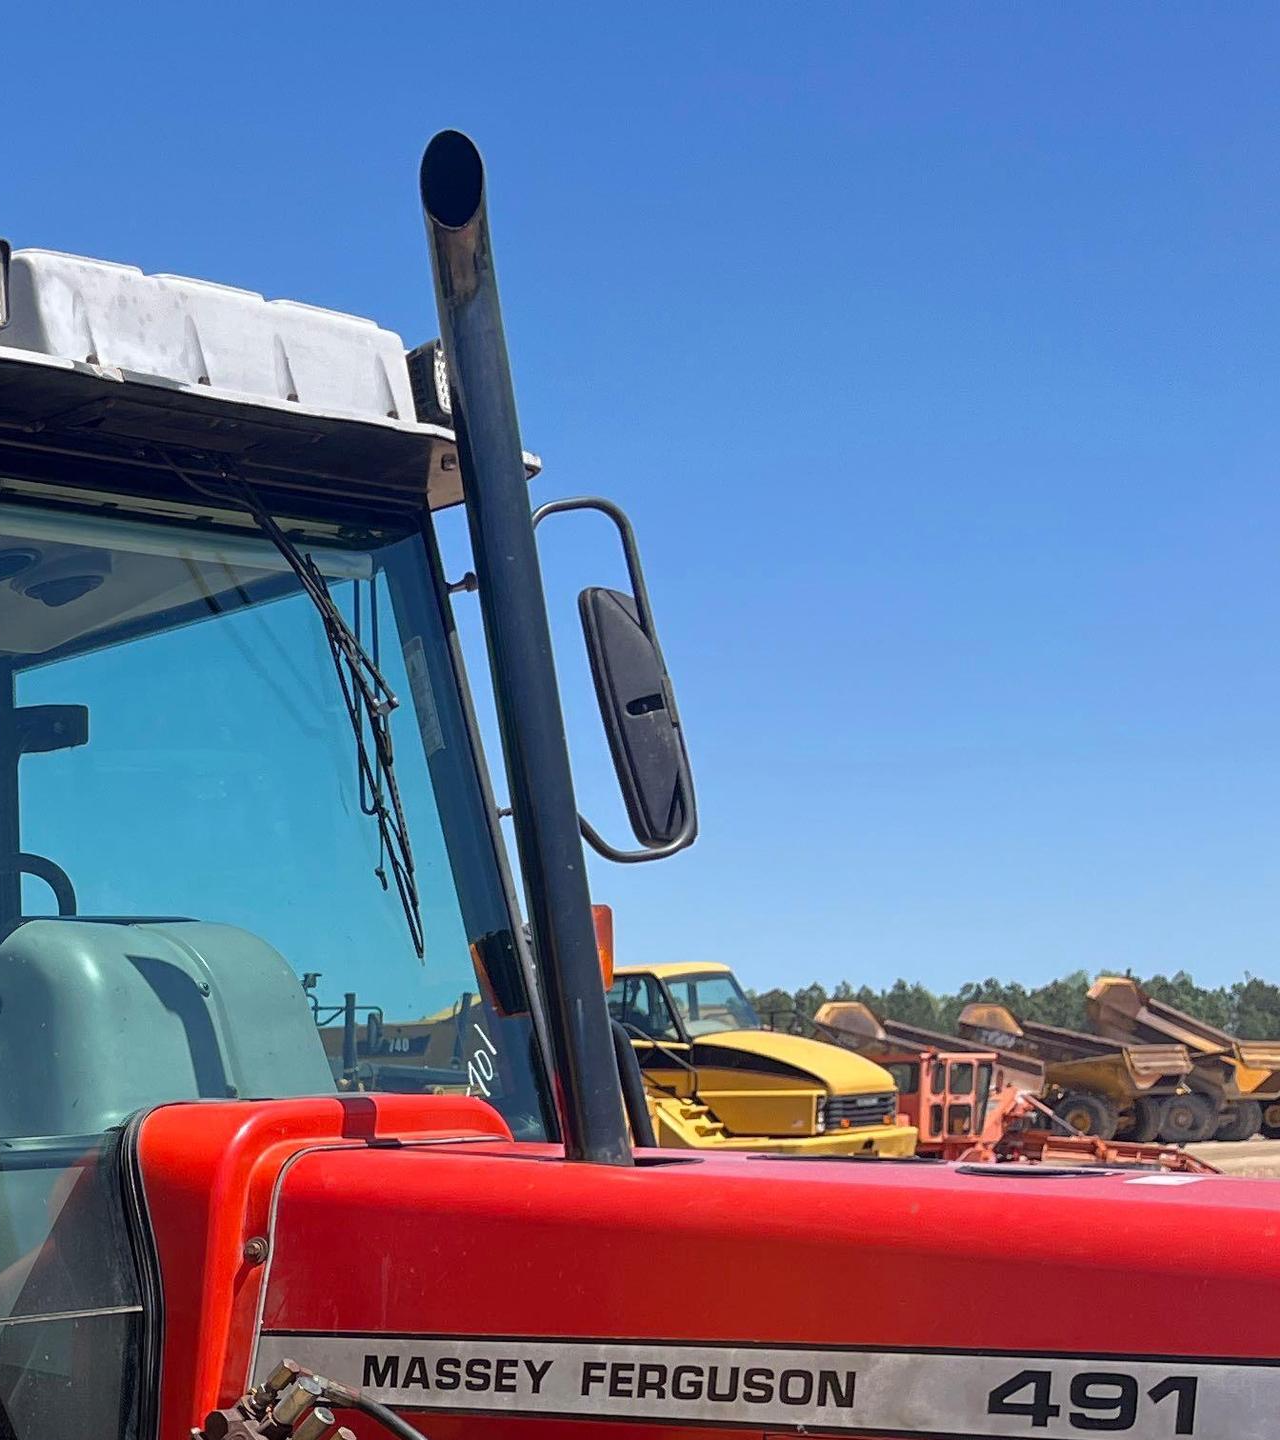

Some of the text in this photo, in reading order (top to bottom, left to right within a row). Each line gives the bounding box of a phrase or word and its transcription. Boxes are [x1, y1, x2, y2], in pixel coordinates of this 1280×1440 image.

[362, 1355, 857, 1408] MASSEY FERGUSON
[988, 1369, 1198, 1435] 491
